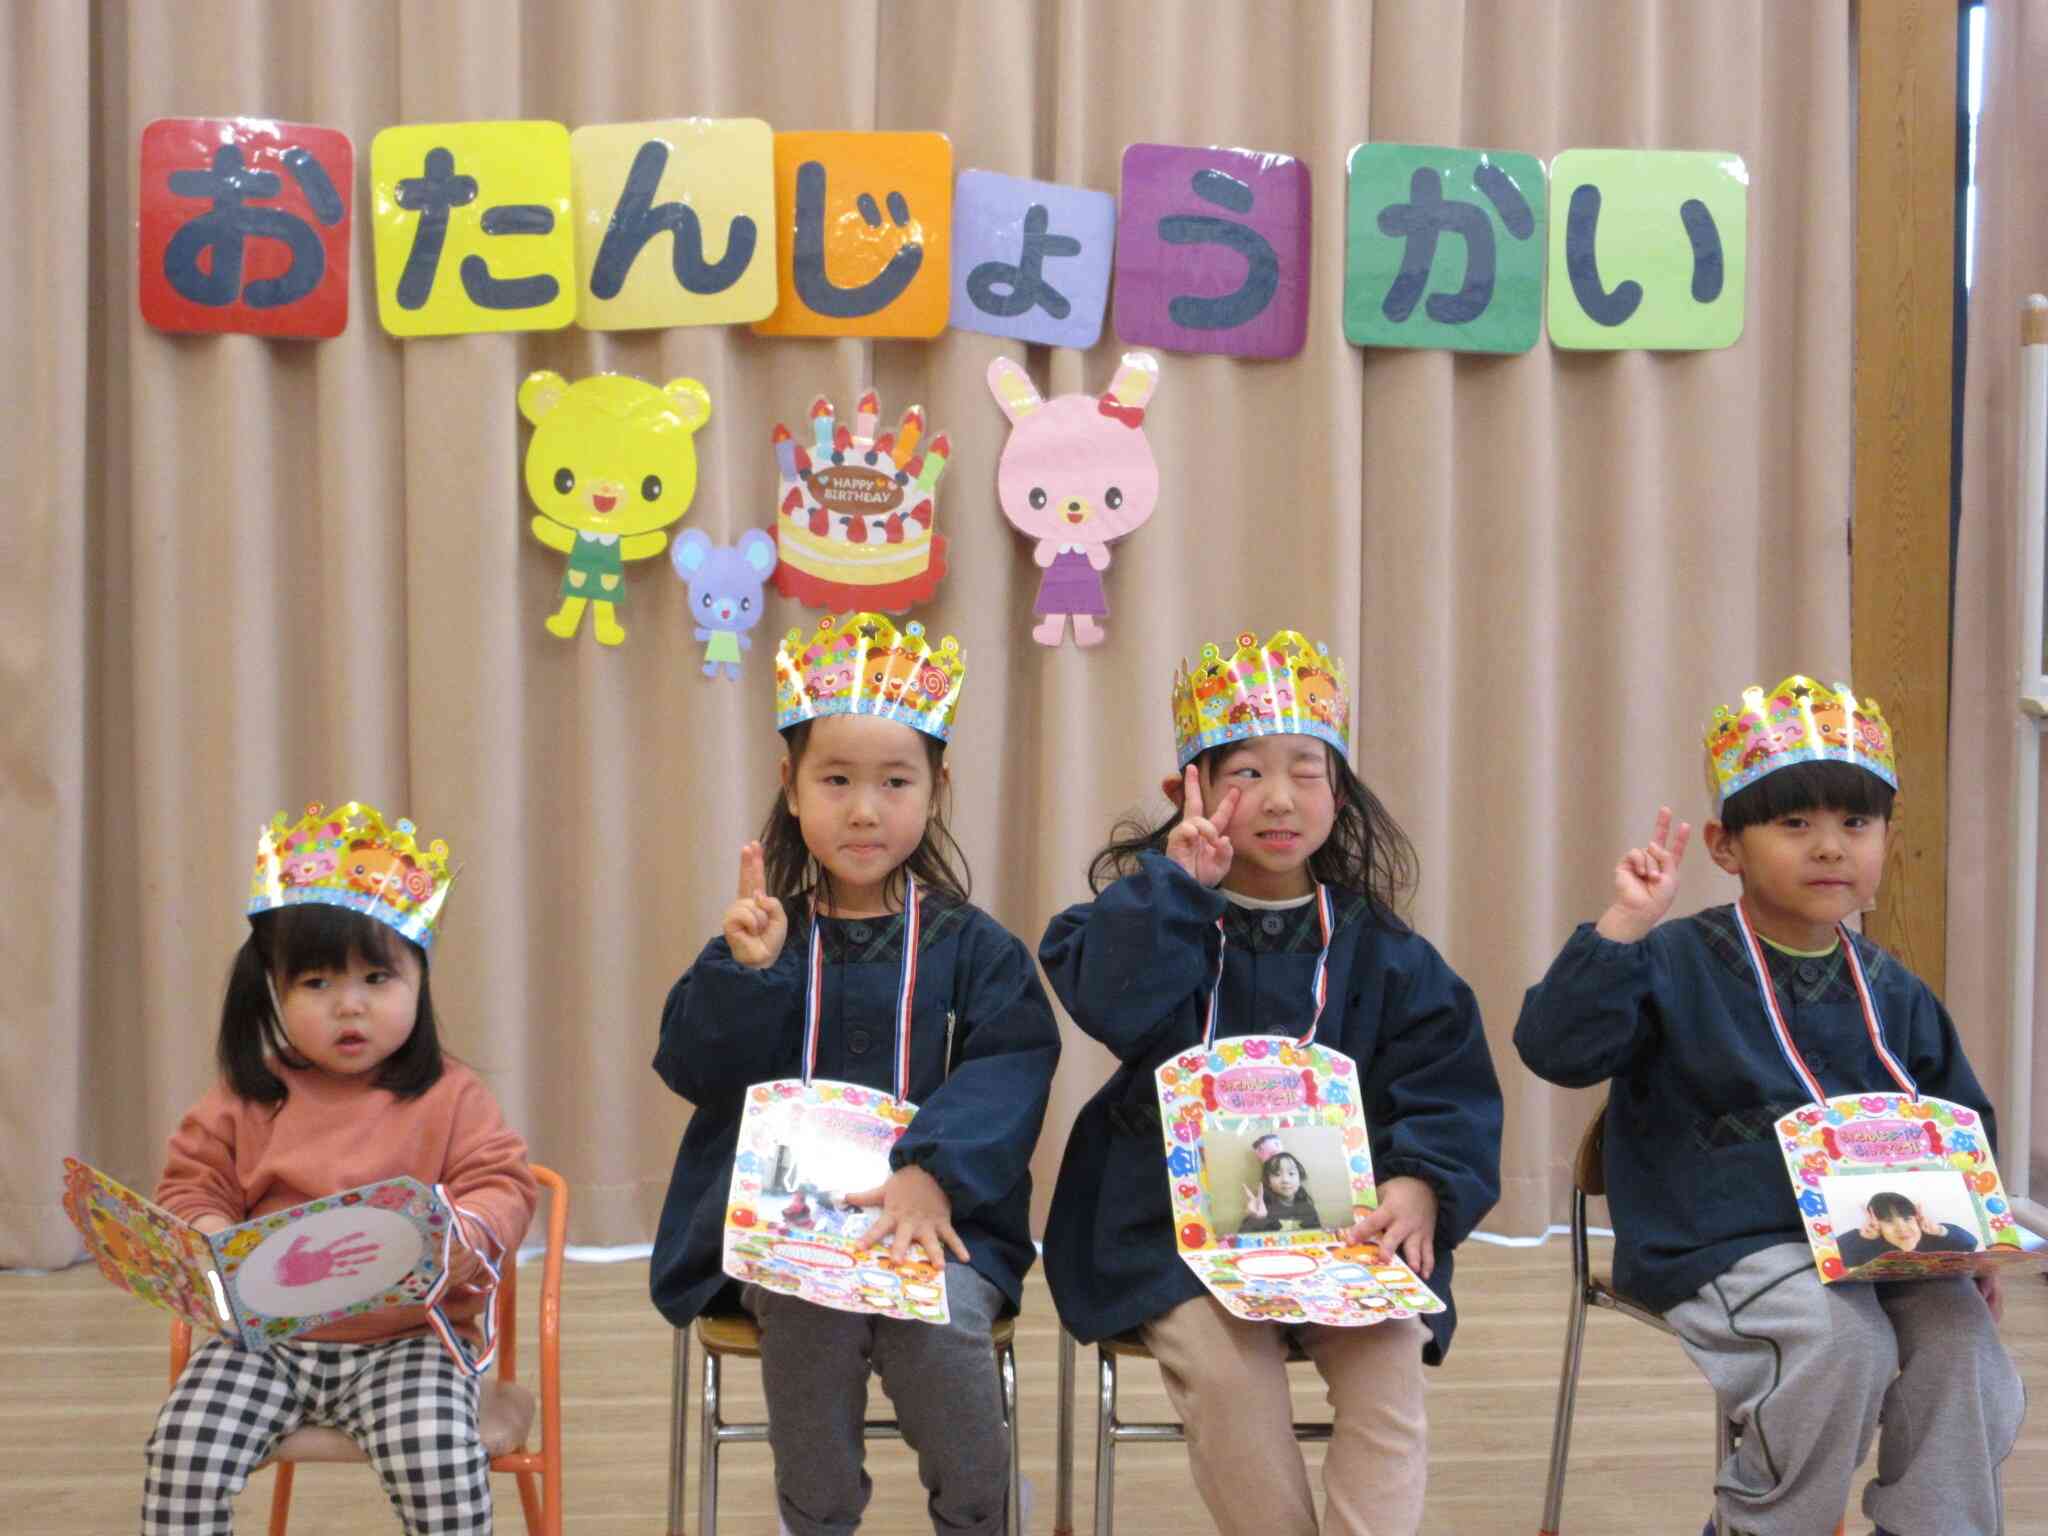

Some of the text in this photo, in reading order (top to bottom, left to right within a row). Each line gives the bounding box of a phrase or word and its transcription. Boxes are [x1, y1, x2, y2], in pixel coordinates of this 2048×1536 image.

[164, 141, 1724, 331] おたんじょうかい
[833, 477, 875, 490] HAPPY
[823, 488, 891, 503] BIRTHDAY
